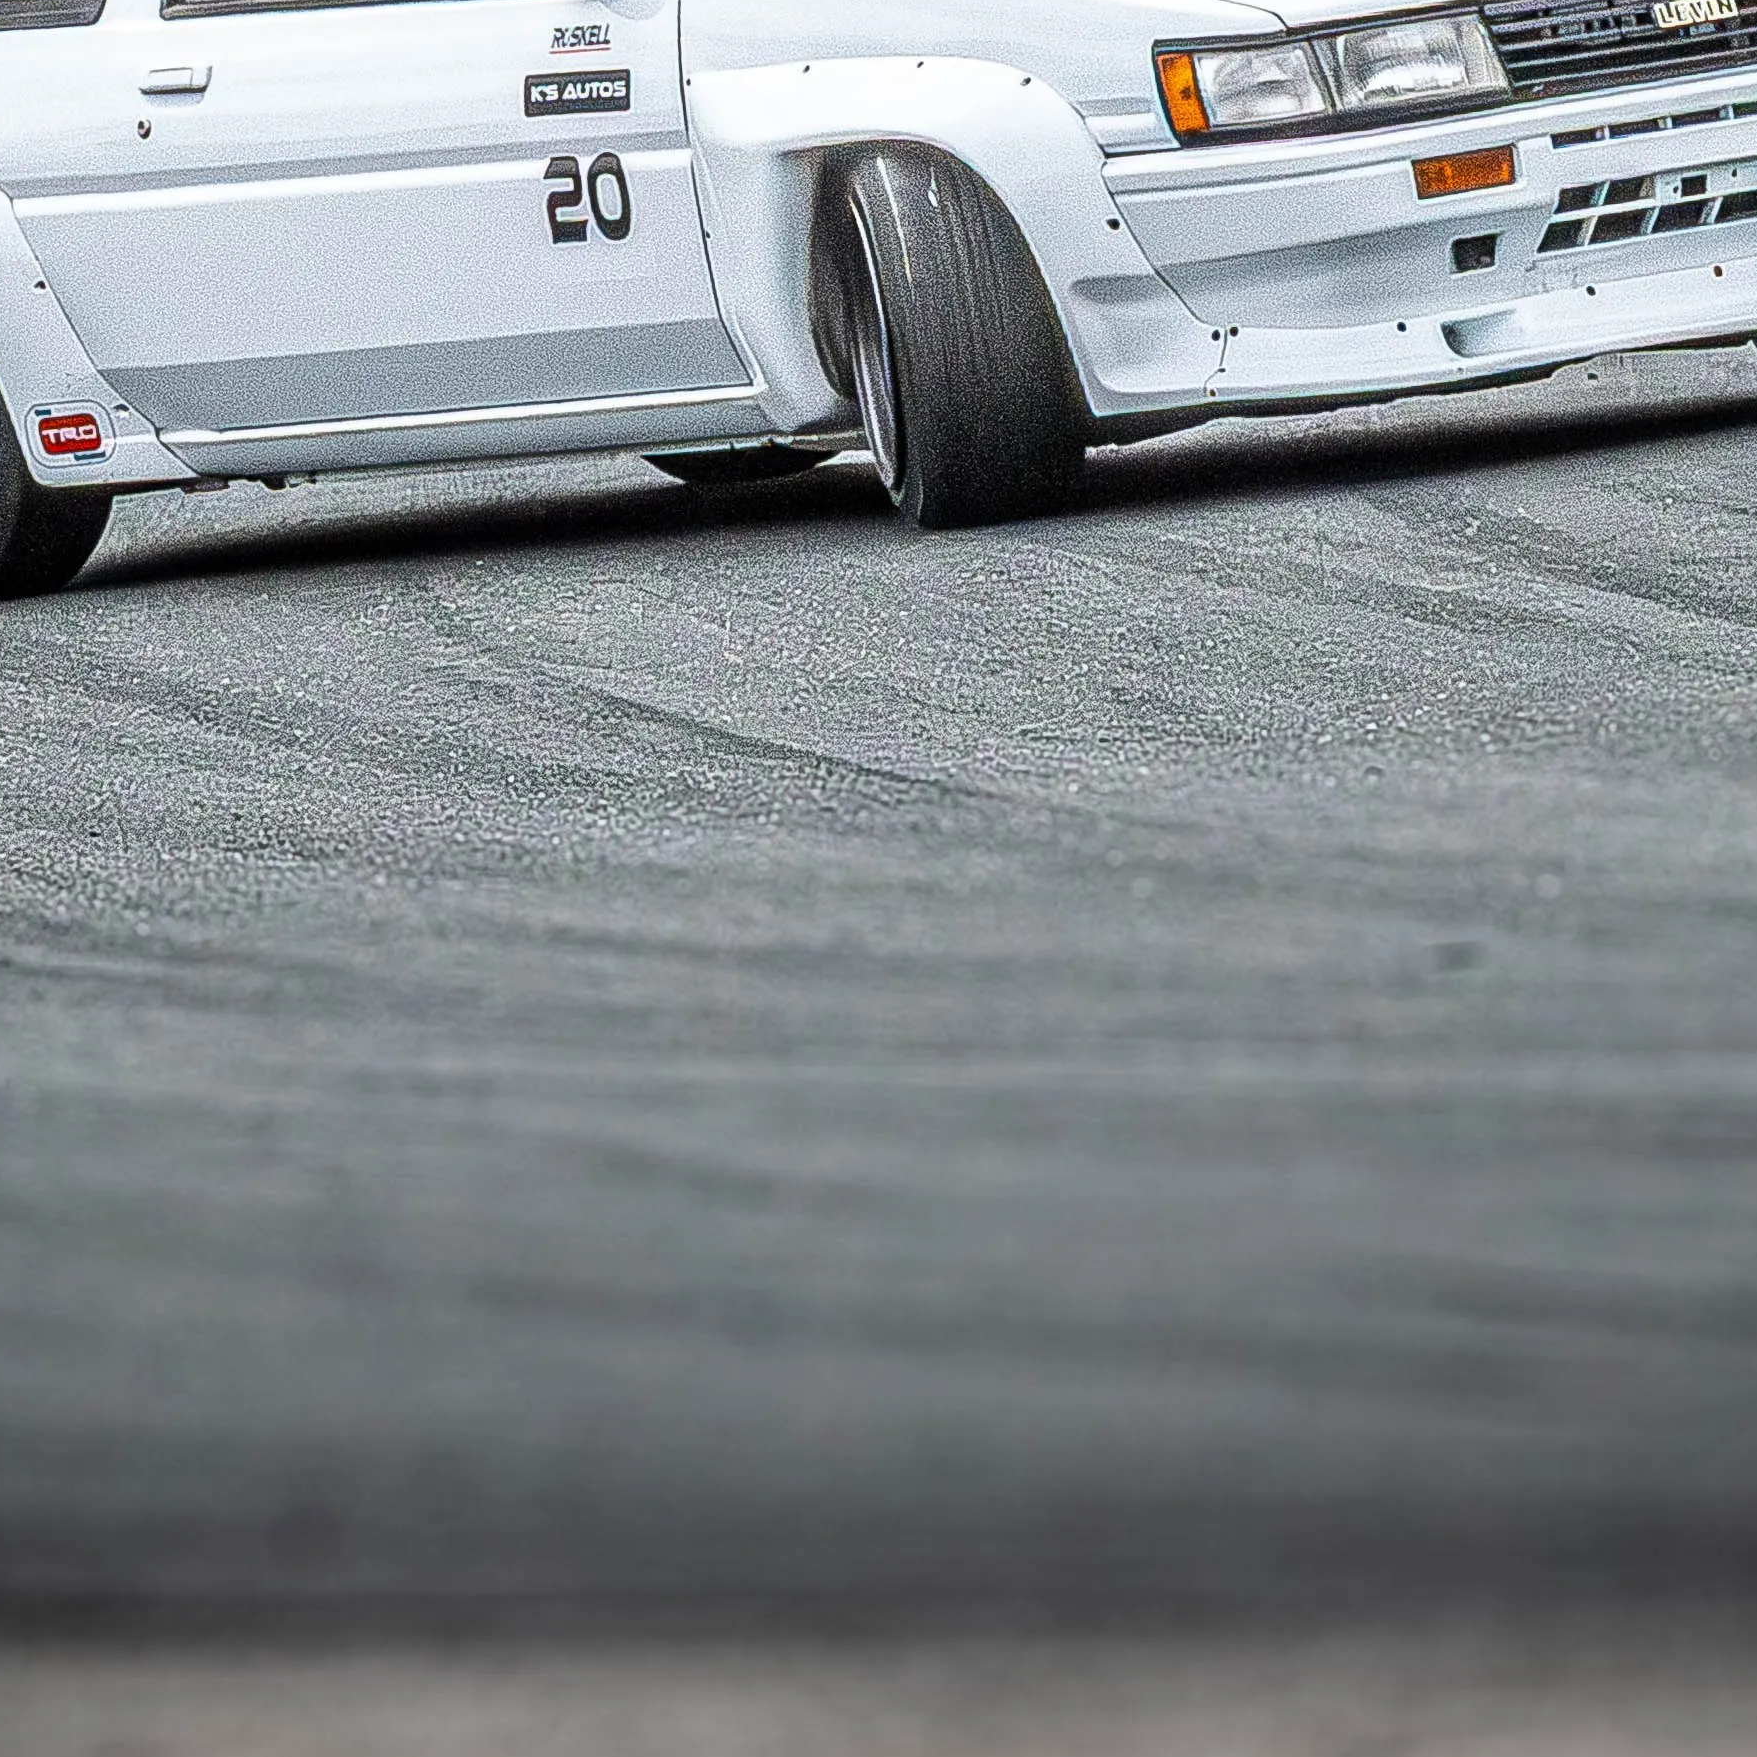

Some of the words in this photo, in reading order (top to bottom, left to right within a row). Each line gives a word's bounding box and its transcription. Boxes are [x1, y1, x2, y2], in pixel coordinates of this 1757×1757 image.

[561, 80, 627, 100] AUTOS
[543, 151, 632, 244] 20
[42, 424, 97, 444] TRD
